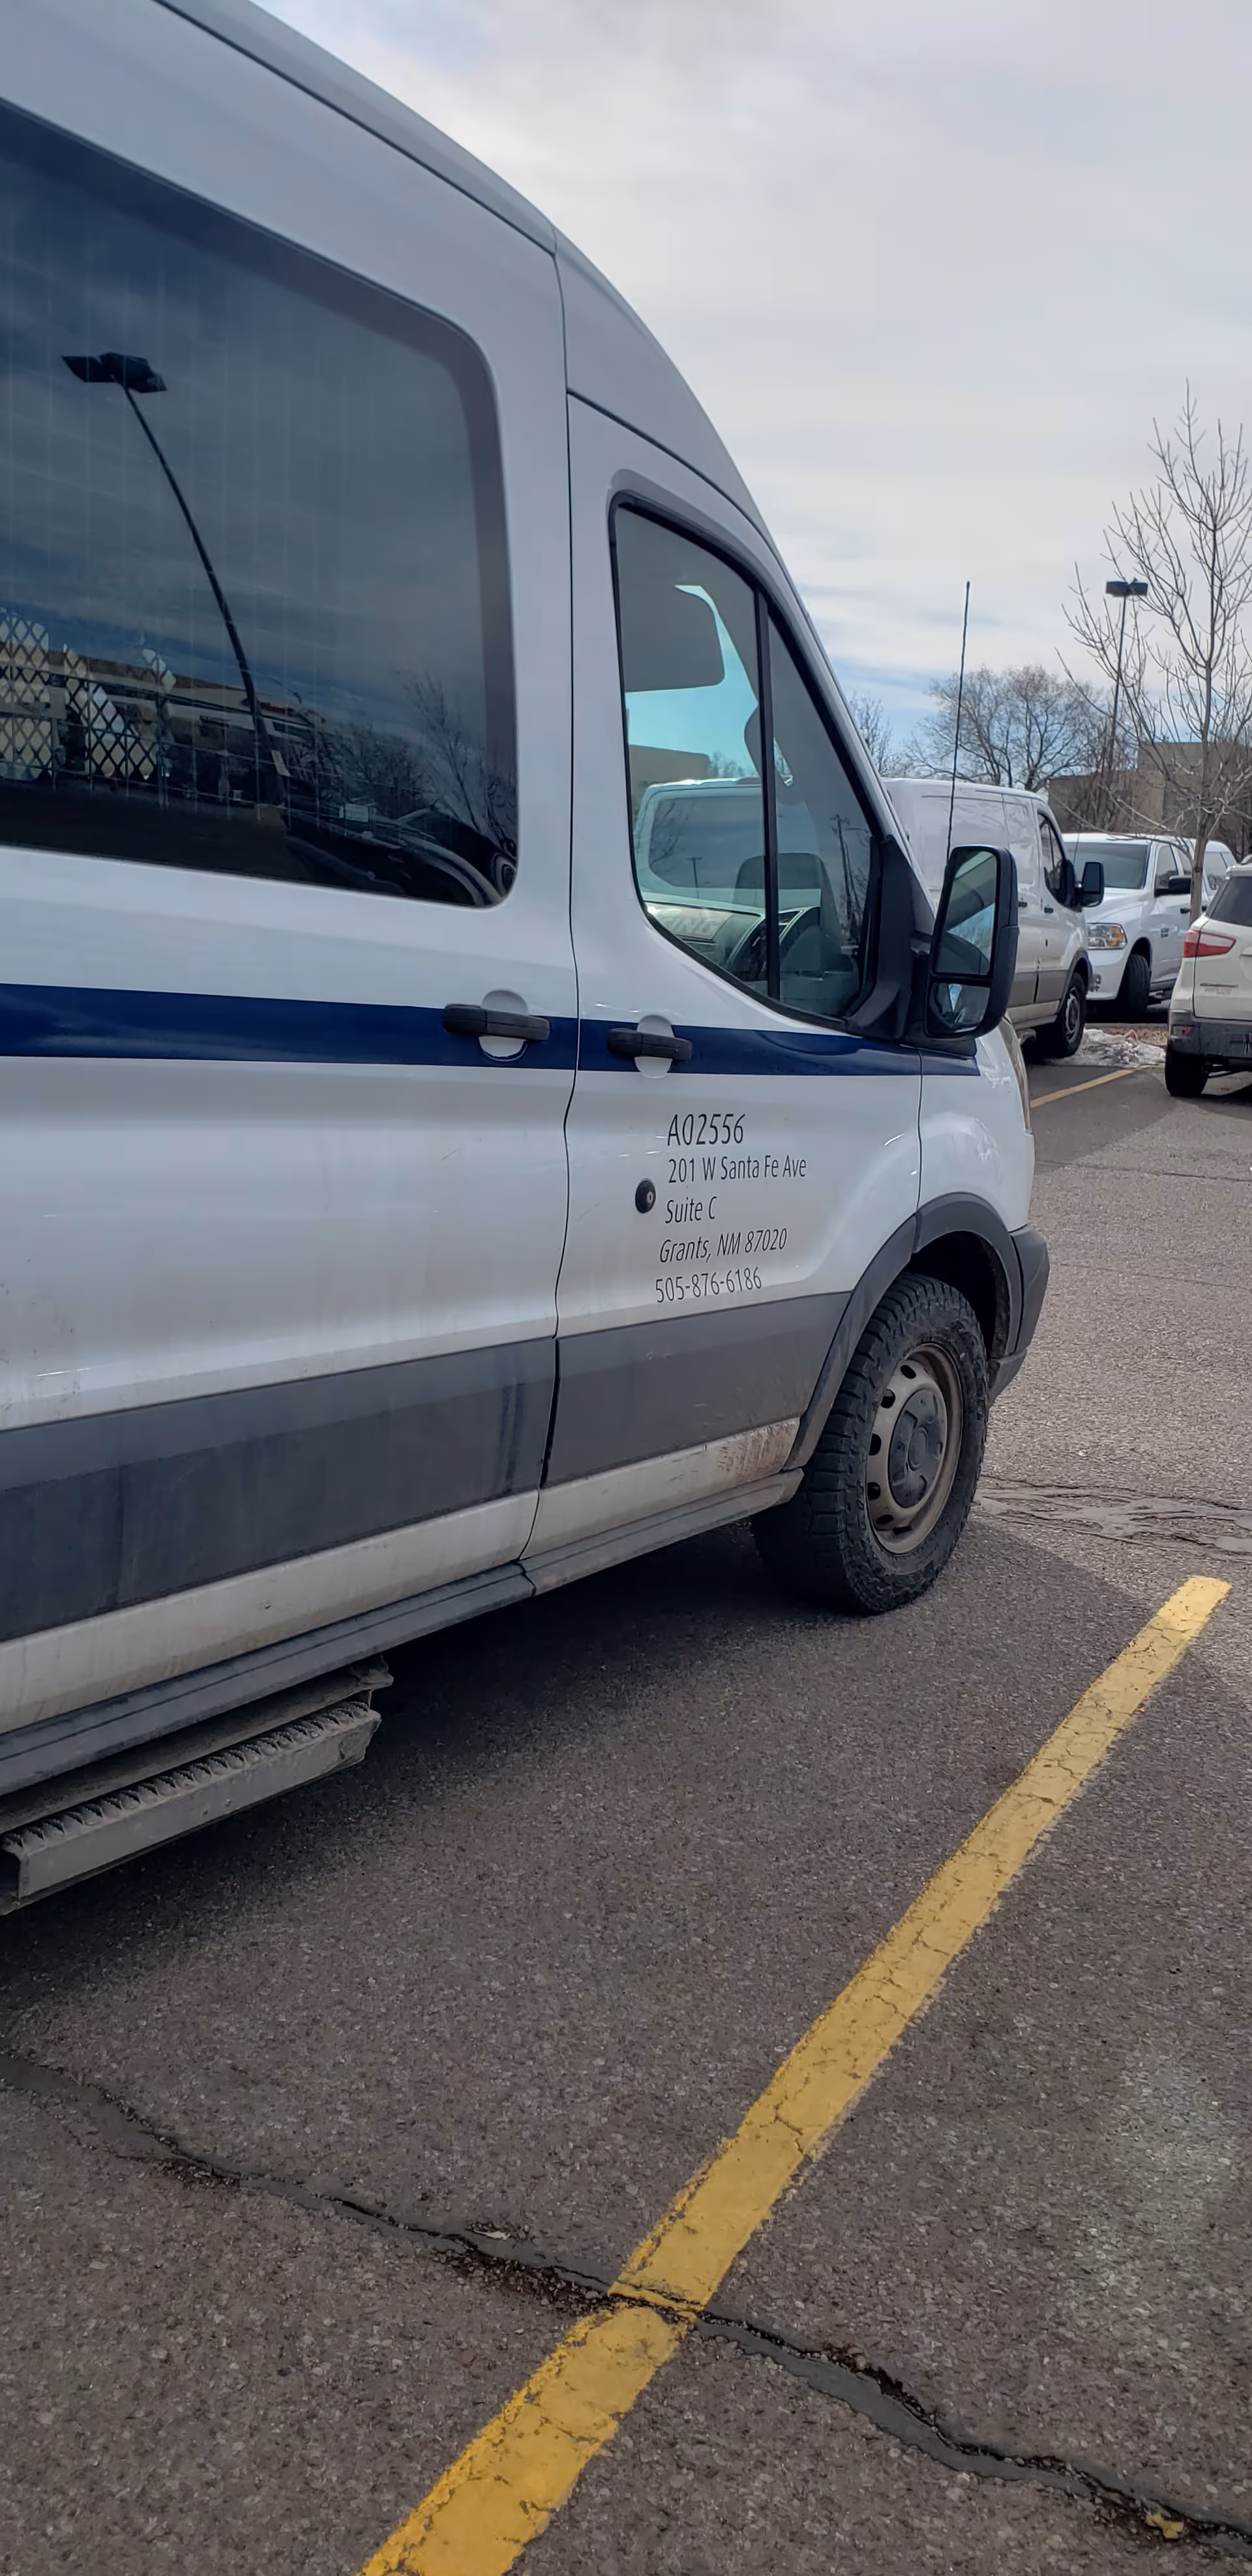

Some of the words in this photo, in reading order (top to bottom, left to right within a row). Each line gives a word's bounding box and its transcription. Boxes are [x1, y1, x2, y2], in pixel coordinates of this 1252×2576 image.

[666, 1113, 746, 1146] A02556
[668, 1158, 695, 1184] 201
[702, 1156, 717, 1182] W
[720, 1155, 760, 1180] Santa
[764, 1154, 779, 1178] Fe
[782, 1154, 807, 1178] Ave
[664, 1196, 703, 1224] Suite
[708, 1195, 717, 1220] C
[659, 1236, 711, 1263] Grants,
[717, 1231, 741, 1257] NM
[744, 1227, 787, 1253] 87020
[655, 1266, 762, 1303] 505-876-6186
